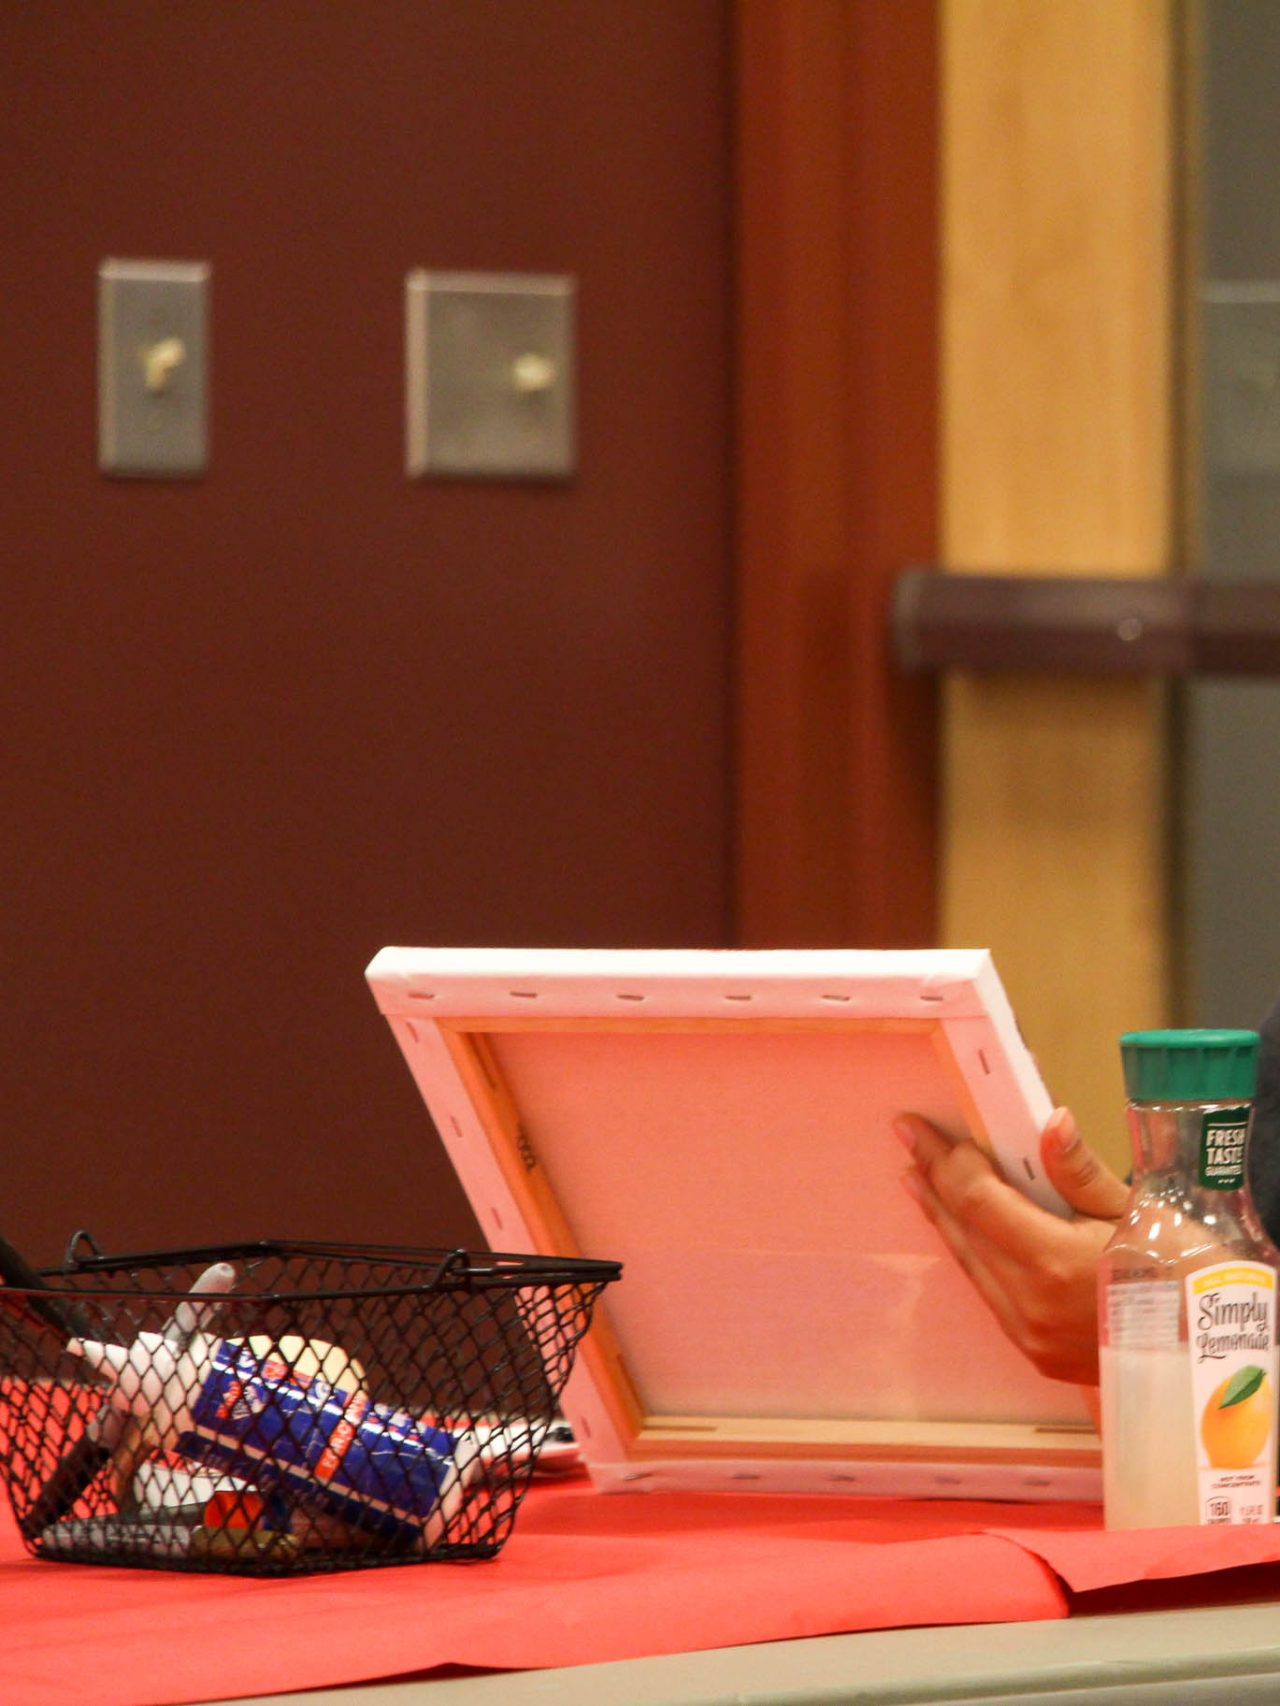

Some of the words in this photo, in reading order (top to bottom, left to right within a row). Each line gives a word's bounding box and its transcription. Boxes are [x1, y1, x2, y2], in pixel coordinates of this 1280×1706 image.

[1206, 1146, 1243, 1165] TASTE
[1197, 1291, 1268, 1331] Simply
[1196, 1333, 1269, 1364] Lemonade
[1210, 1501, 1229, 1516] 160
